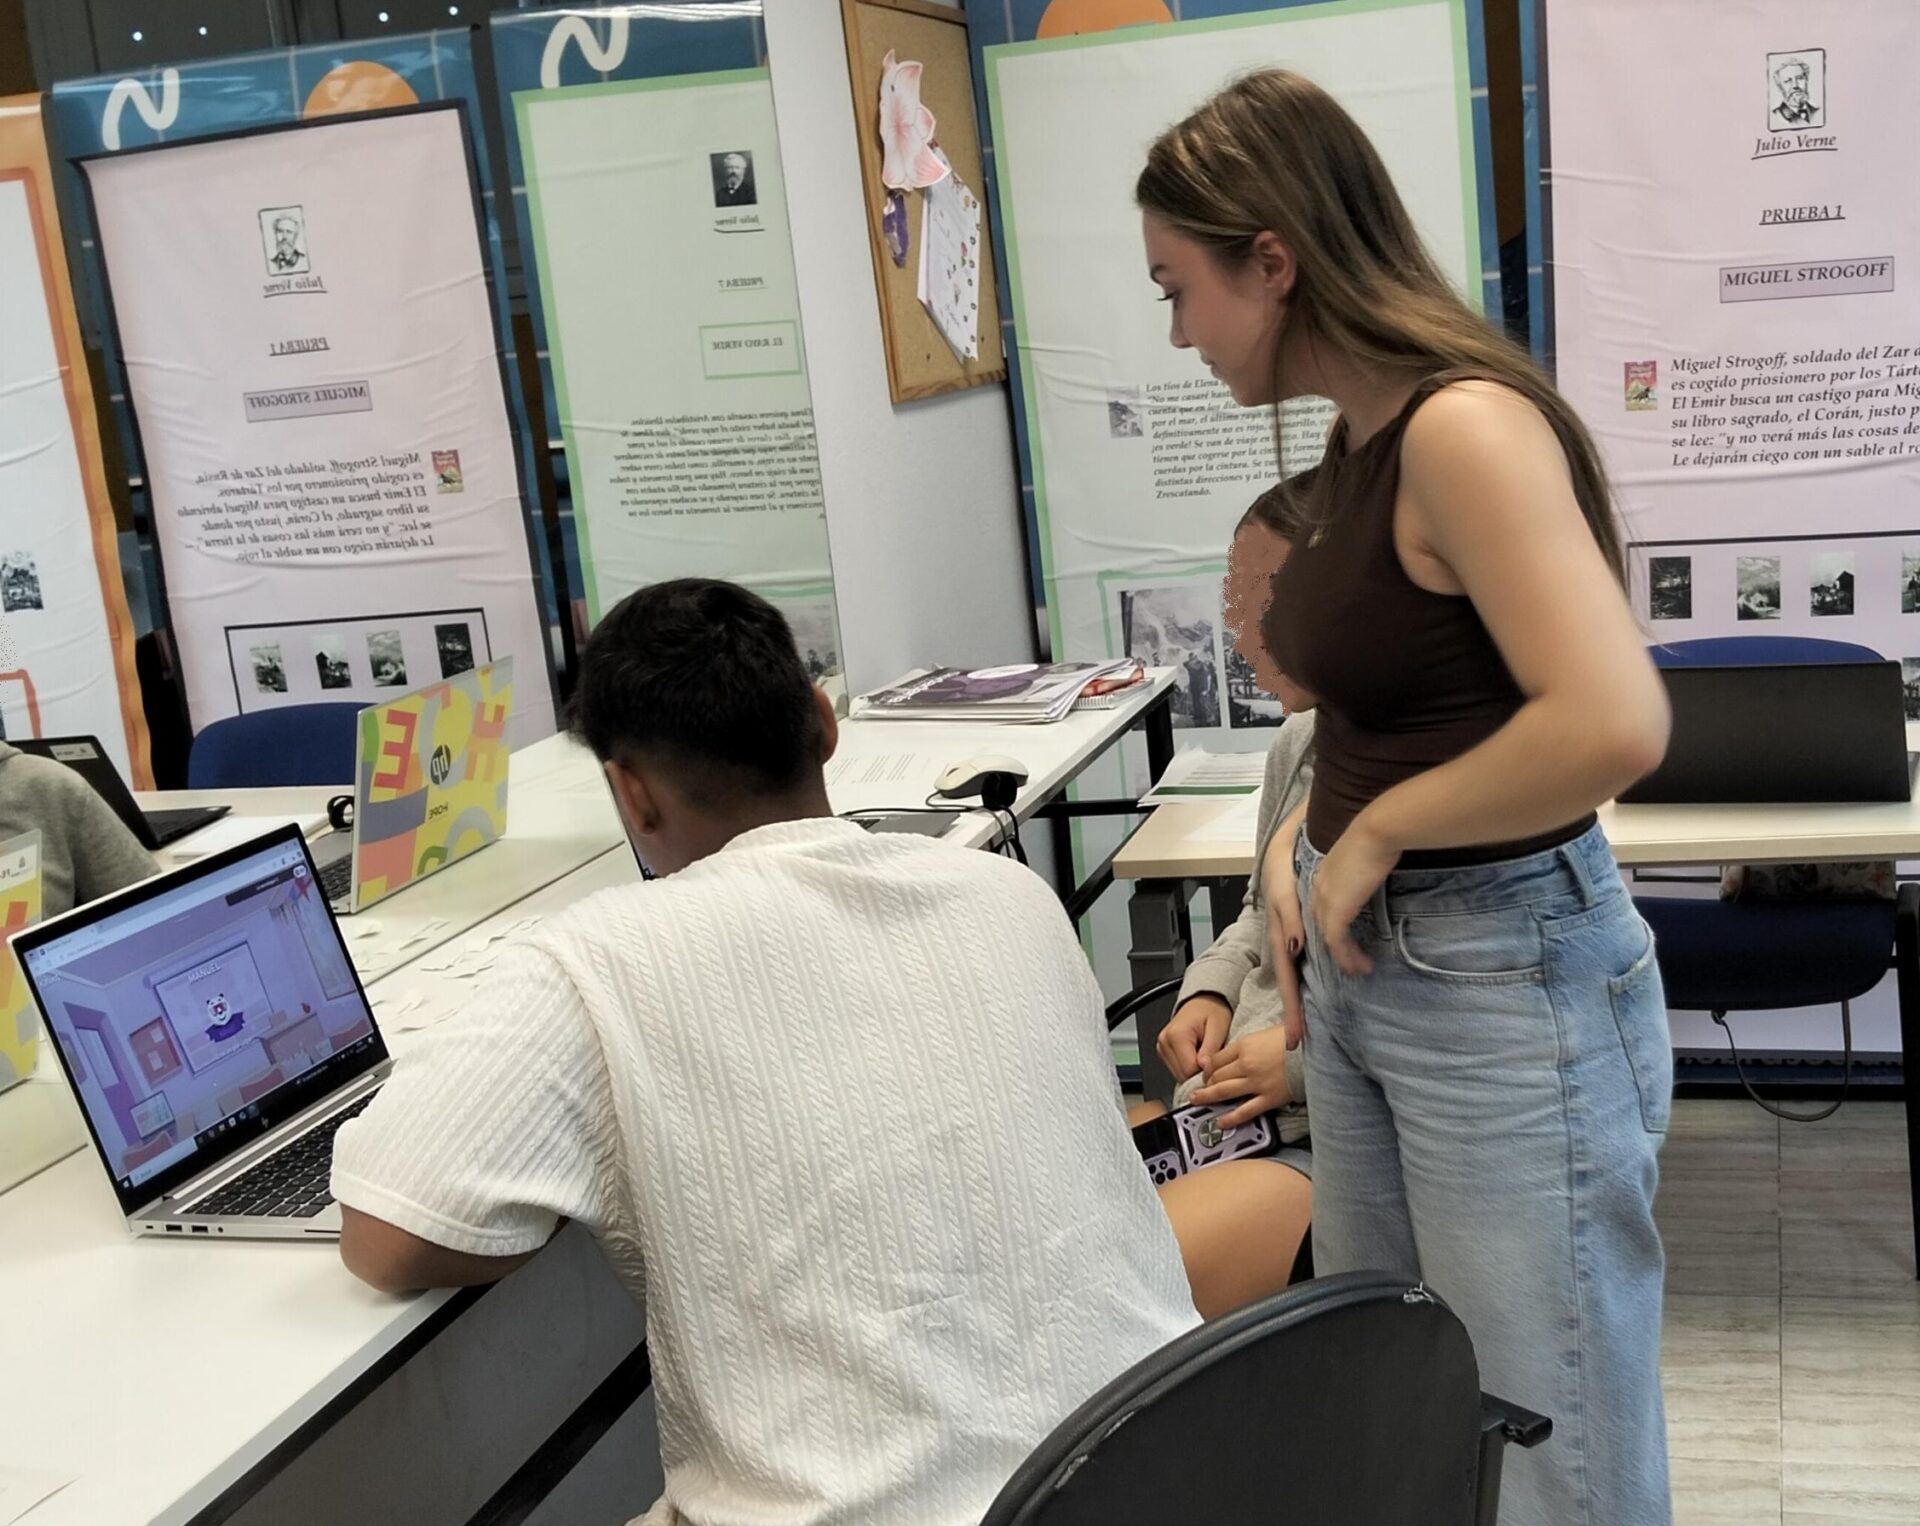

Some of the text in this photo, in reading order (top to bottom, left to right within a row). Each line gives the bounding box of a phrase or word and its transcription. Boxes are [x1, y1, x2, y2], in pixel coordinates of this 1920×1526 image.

[1755, 134, 1837, 155] Julio Verne
[1761, 204, 1843, 223] PRUEBA 1
[1724, 262, 1889, 286] MIGUEL STROGOFF
[1670, 356, 1721, 375] Miguel
[1725, 352, 1788, 370] Strogoff,
[1792, 348, 1852, 364] soldado
[1855, 346, 1878, 360] del
[1882, 345, 1910, 358] Zar
[1671, 380, 1686, 391] es
[1689, 375, 1737, 393] cogido
[1740, 371, 1826, 391] priosionero
[1829, 371, 1856, 385] por
[1859, 367, 1881, 379] los
[1672, 388, 1890, 410] El Emir busca un castigo para
[1671, 419, 1687, 429] su
[1692, 414, 1726, 427] libro
[1730, 410, 1793, 429] sagrado,
[1797, 408, 1811, 422] el
[1814, 406, 1864, 421] Corán,
[1867, 404, 1906, 422] justo
[1671, 437, 1687, 448] se
[1690, 433, 1715, 447] lee:
[1739, 434, 1757, 444] no
[1761, 428, 1793, 443] verá
[1797, 427, 1828, 441] más
[1832, 426, 1854, 439] las
[1858, 425, 1899, 438] cosas
[1903, 421, 1920, 435] de
[1672, 441, 1904, 468] Le dejarán ciego con un sable al
[187, 962, 221, 985] MANUEL
